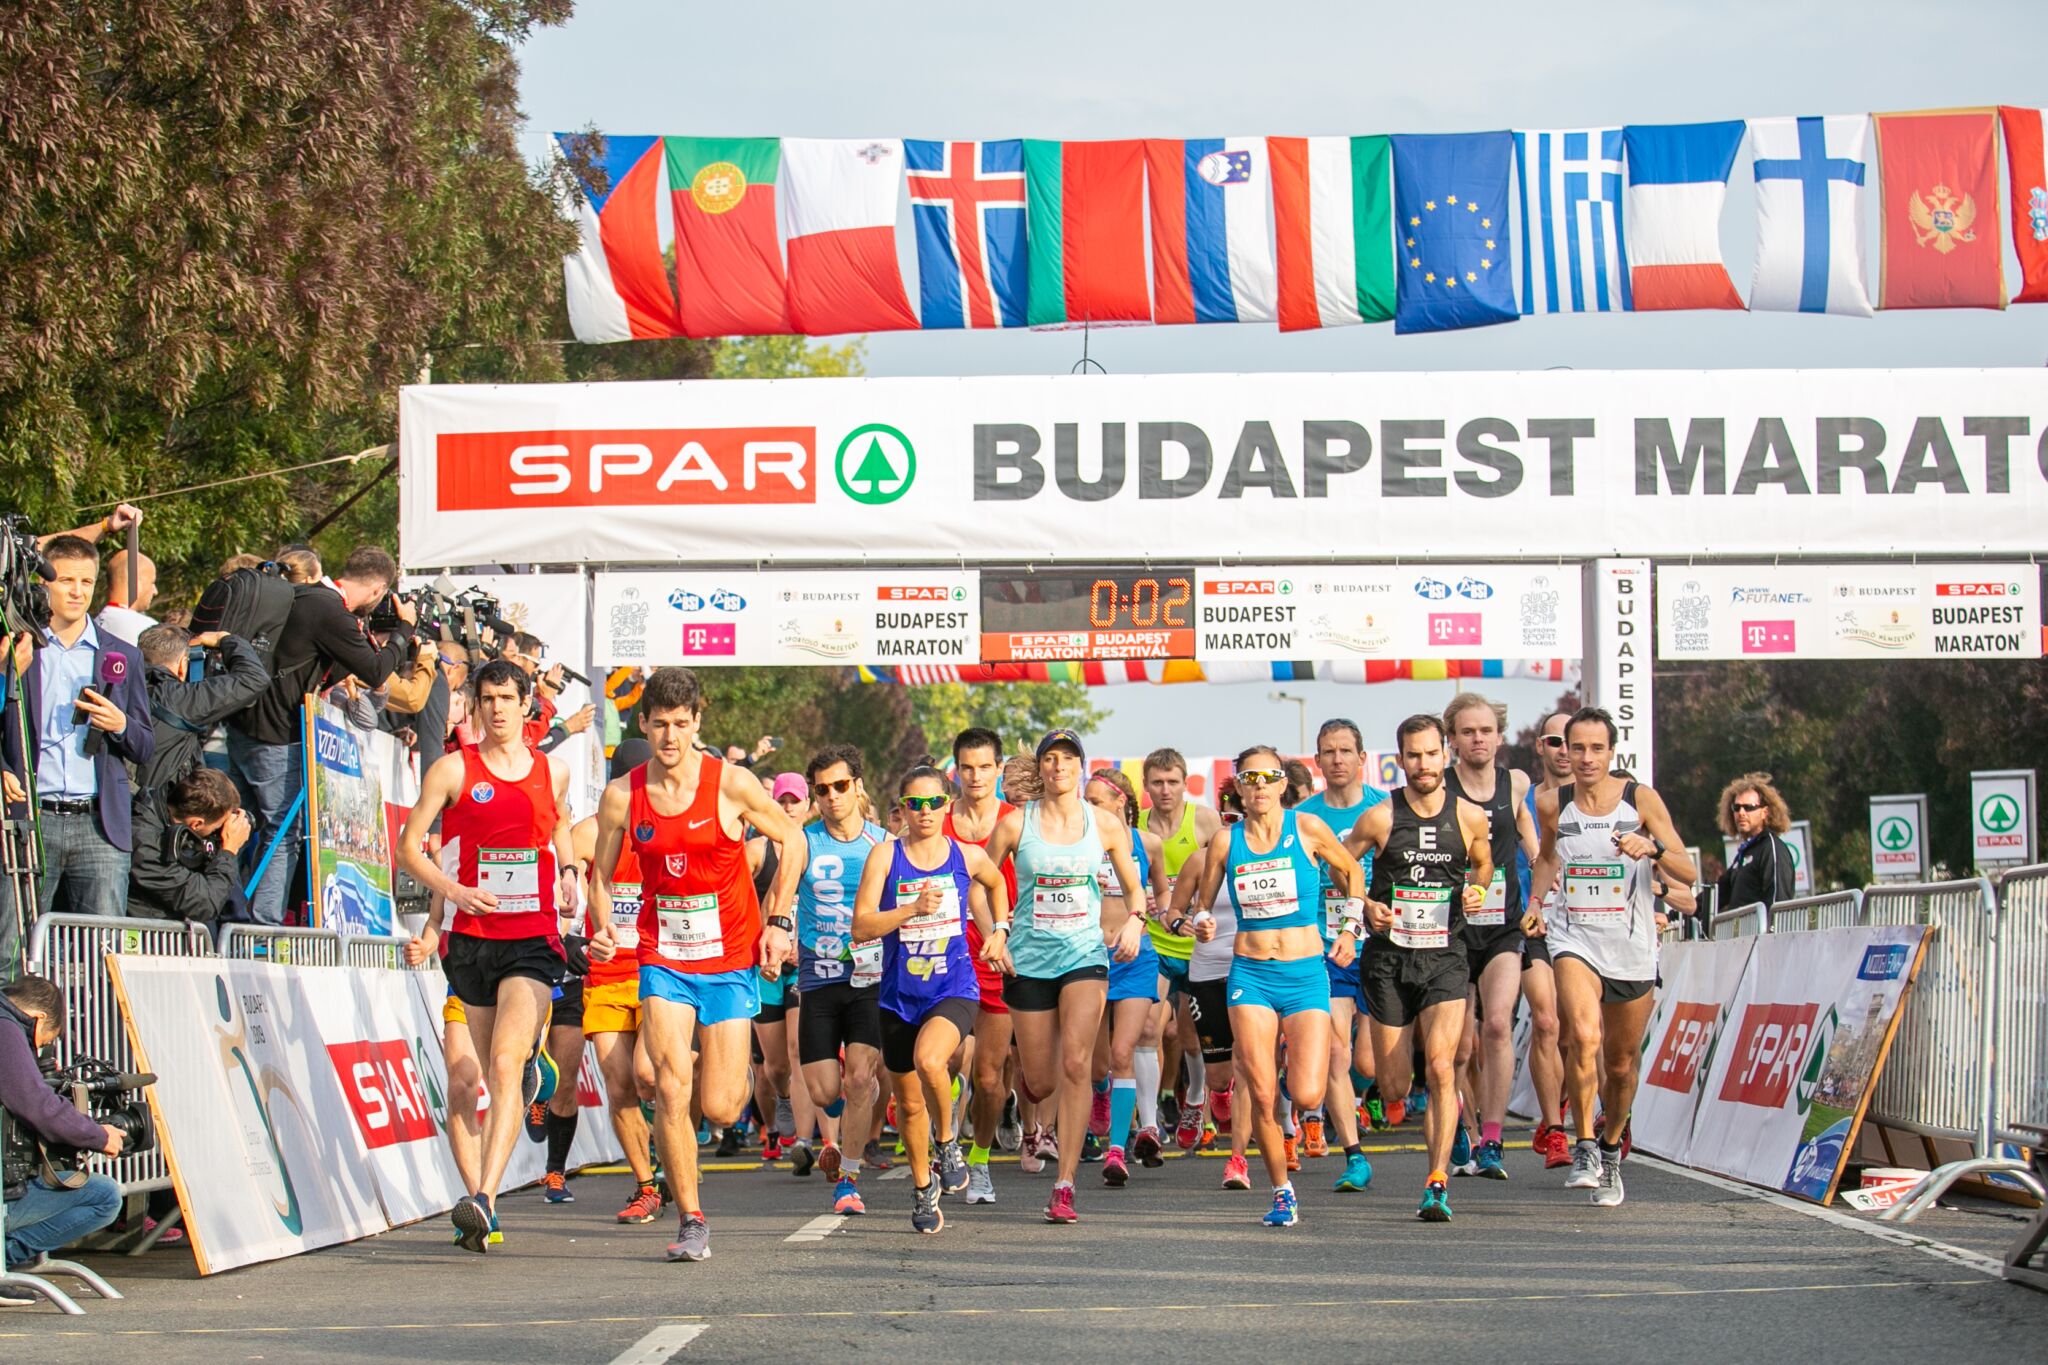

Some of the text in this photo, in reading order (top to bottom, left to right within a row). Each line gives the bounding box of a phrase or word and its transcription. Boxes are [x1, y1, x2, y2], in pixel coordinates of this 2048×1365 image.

[972, 417, 1596, 501] BUDAPEST
[509, 441, 807, 495] SPAR
[1216, 582, 1274, 593] SPAR
[1333, 584, 1392, 593] BUDAPEST
[1859, 587, 1917, 596] BUDAPEST
[1948, 584, 2004, 595] SPAR
[802, 592, 861, 601] BUDAPEST
[890, 588, 947, 599] SPAR
[1090, 578, 1190, 628] 0:02
[1203, 606, 1296, 623] BUDAPEST
[1932, 607, 2024, 624] BUDAPEST
[876, 612, 968, 629] BUDAPEST
[1021, 633, 1171, 645] SPAR BUDAPEST
[1205, 633, 1291, 650] MARATON
[1935, 635, 2020, 652] MARATON
[877, 639, 963, 656] MARATON
[1011, 648, 1085, 660] MARATON
[1617, 579, 1635, 741] BUDAPEST
[1419, 826, 1437, 849] E
[1978, 836, 2021, 846] SPAR
[1416, 852, 1451, 863] evopro
[1876, 853, 1915, 863] SPAR
[1243, 860, 1278, 872] SPAR
[505, 871, 513, 881] 7
[1044, 877, 1076, 886] SPAR
[1252, 878, 1277, 890] 102
[1402, 891, 1436, 899] SPAR
[1587, 886, 1599, 895] 11
[1050, 893, 1074, 903] 105
[665, 901, 699, 909] SPAR
[1416, 909, 1425, 919] 2
[682, 920, 690, 930] 3
[1740, 1023, 1808, 1089] SPAR
